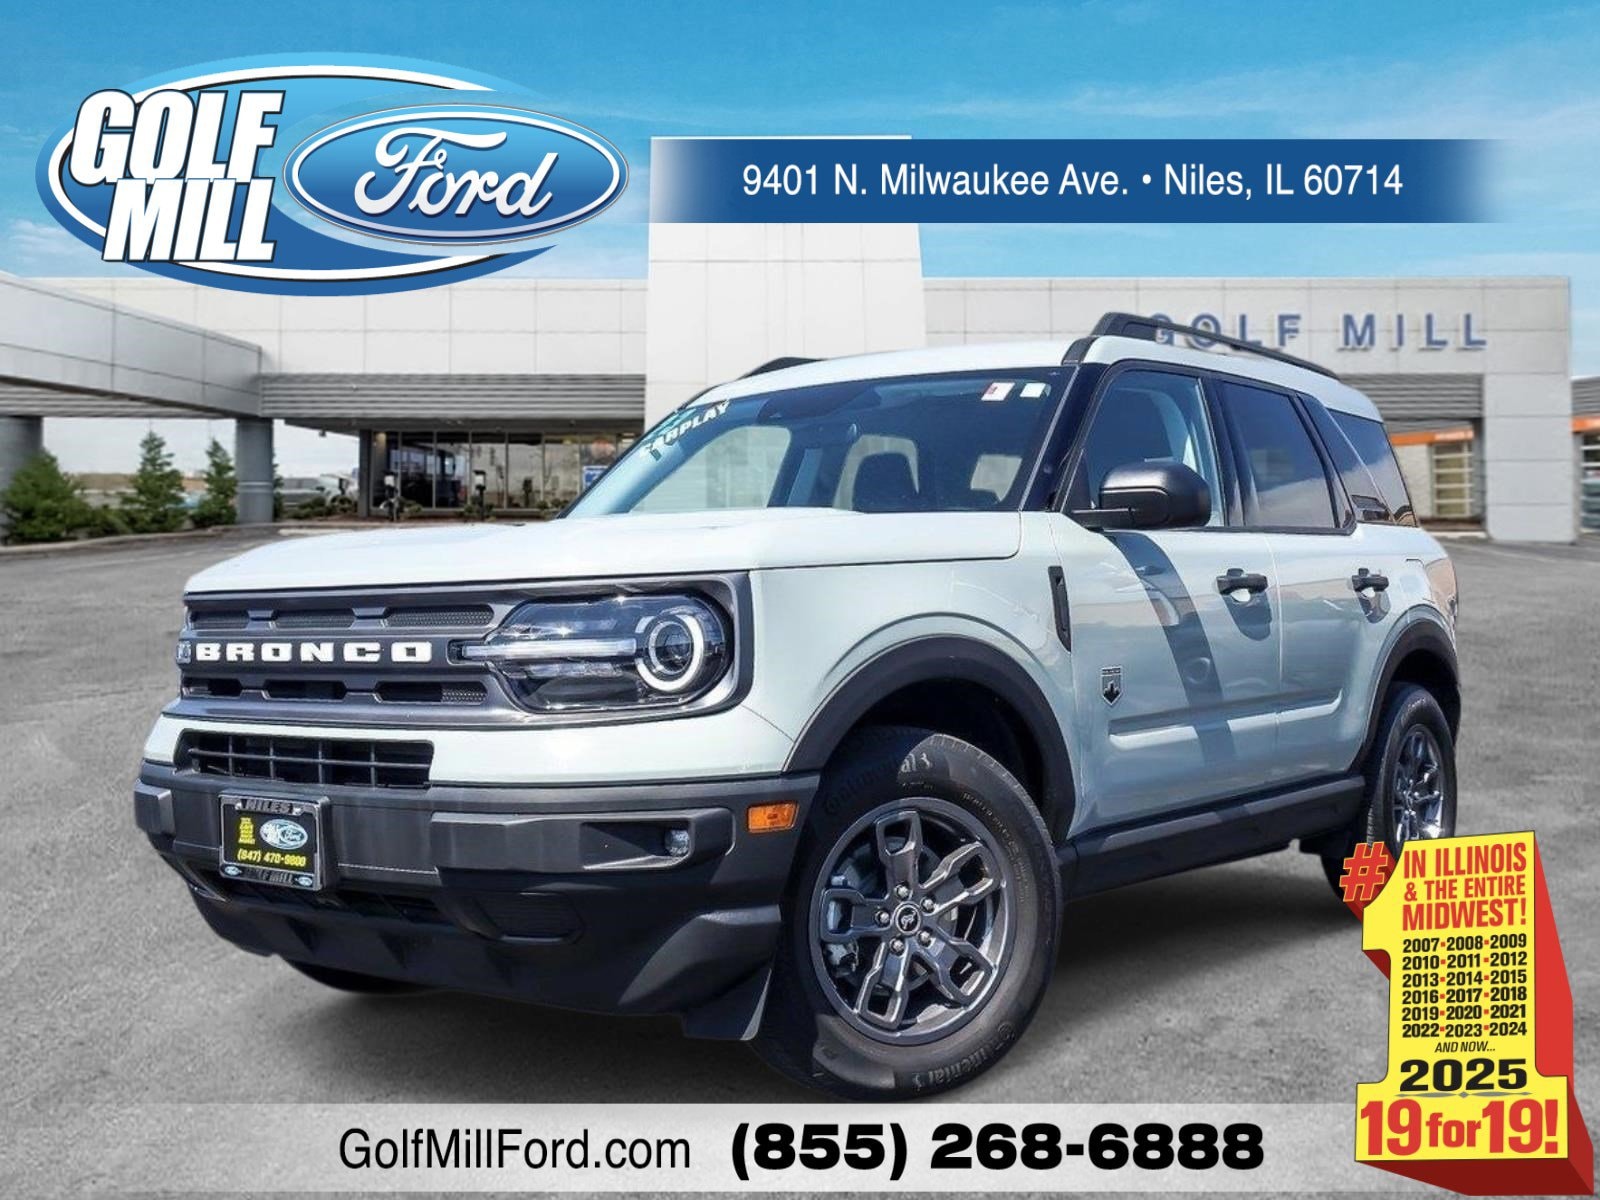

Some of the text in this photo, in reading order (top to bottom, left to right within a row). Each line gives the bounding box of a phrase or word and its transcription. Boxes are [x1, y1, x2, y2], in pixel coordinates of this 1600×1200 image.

[1342, 313, 1487, 347] MILL
[195, 640, 433, 663] BRONCO
[237, 848, 261, 863] (847)
